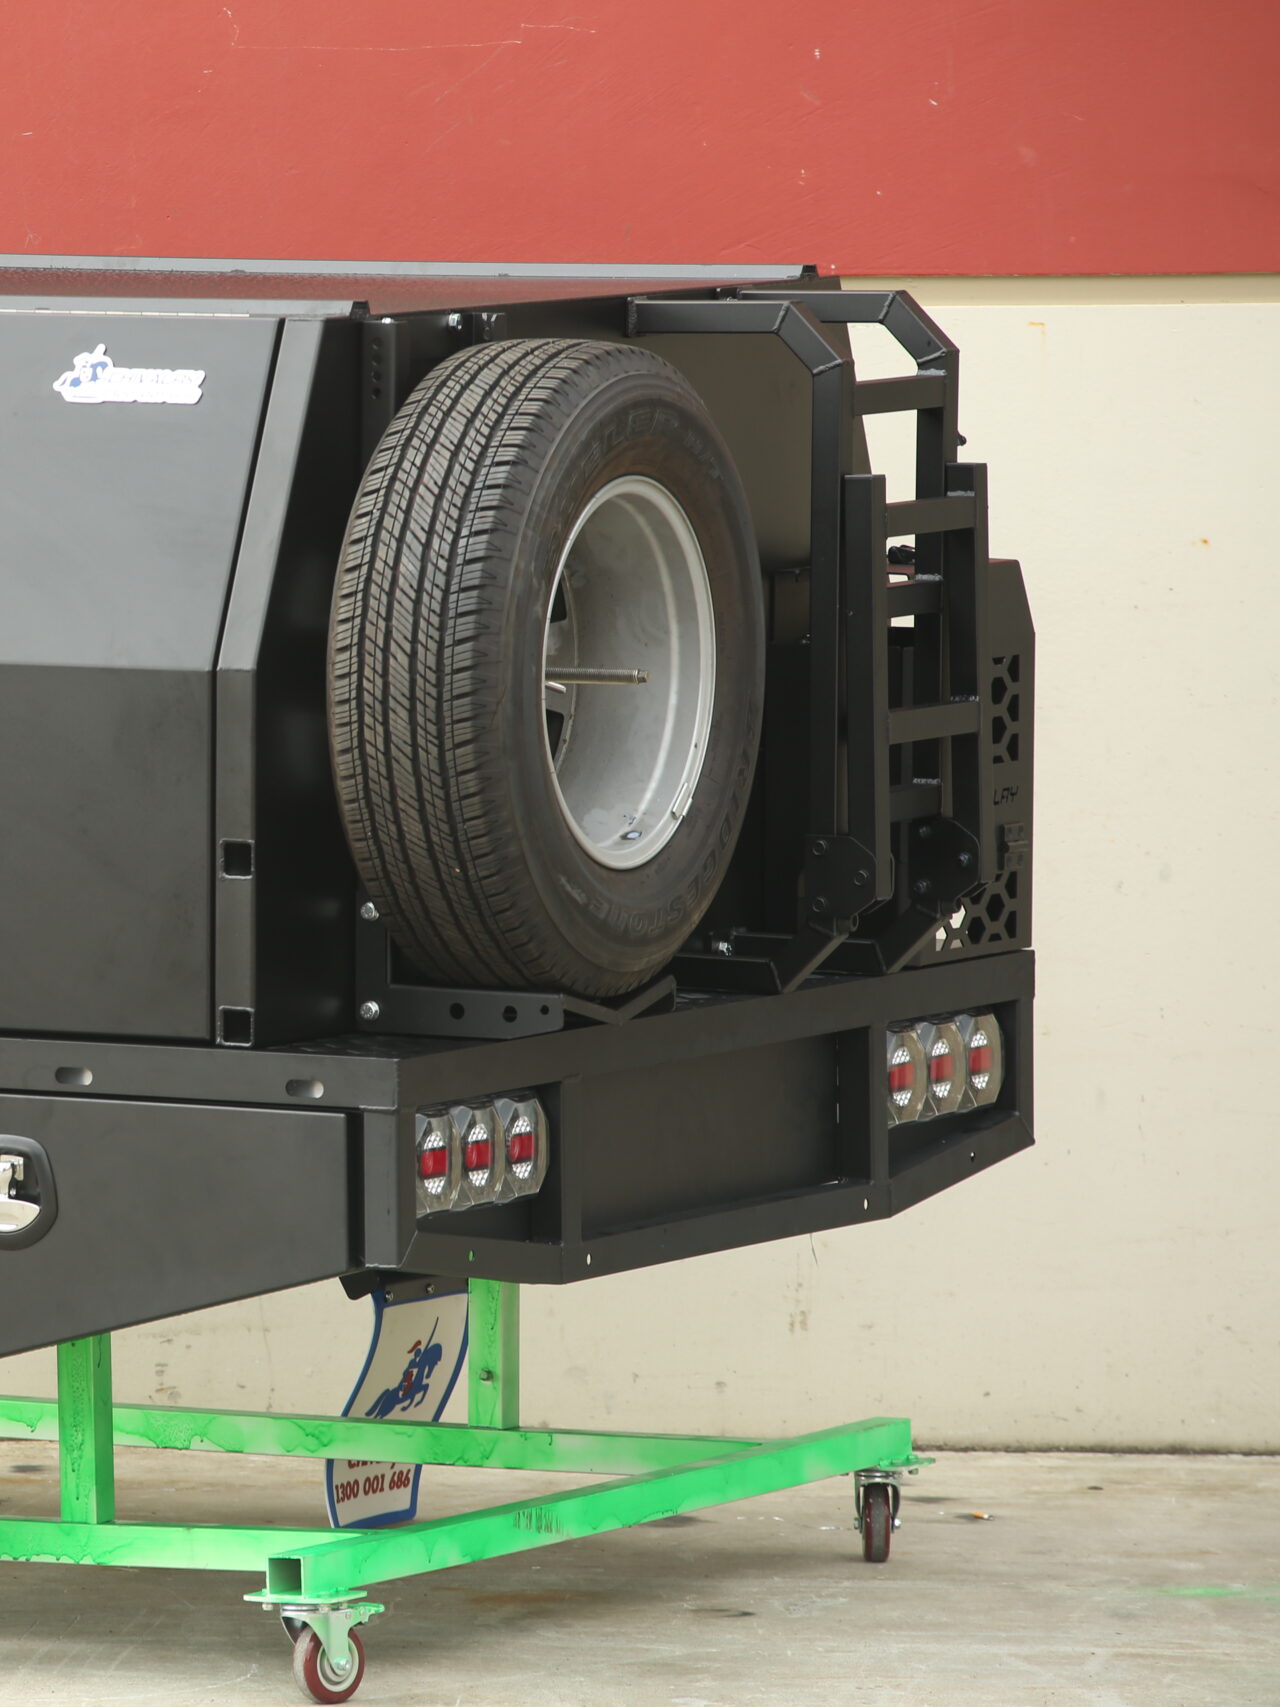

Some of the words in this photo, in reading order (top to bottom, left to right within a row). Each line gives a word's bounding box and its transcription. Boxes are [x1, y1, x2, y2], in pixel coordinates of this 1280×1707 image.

[335, 1478, 360, 1504] 1300
[363, 1473, 385, 1496] 001
[389, 1468, 411, 1491] 686
